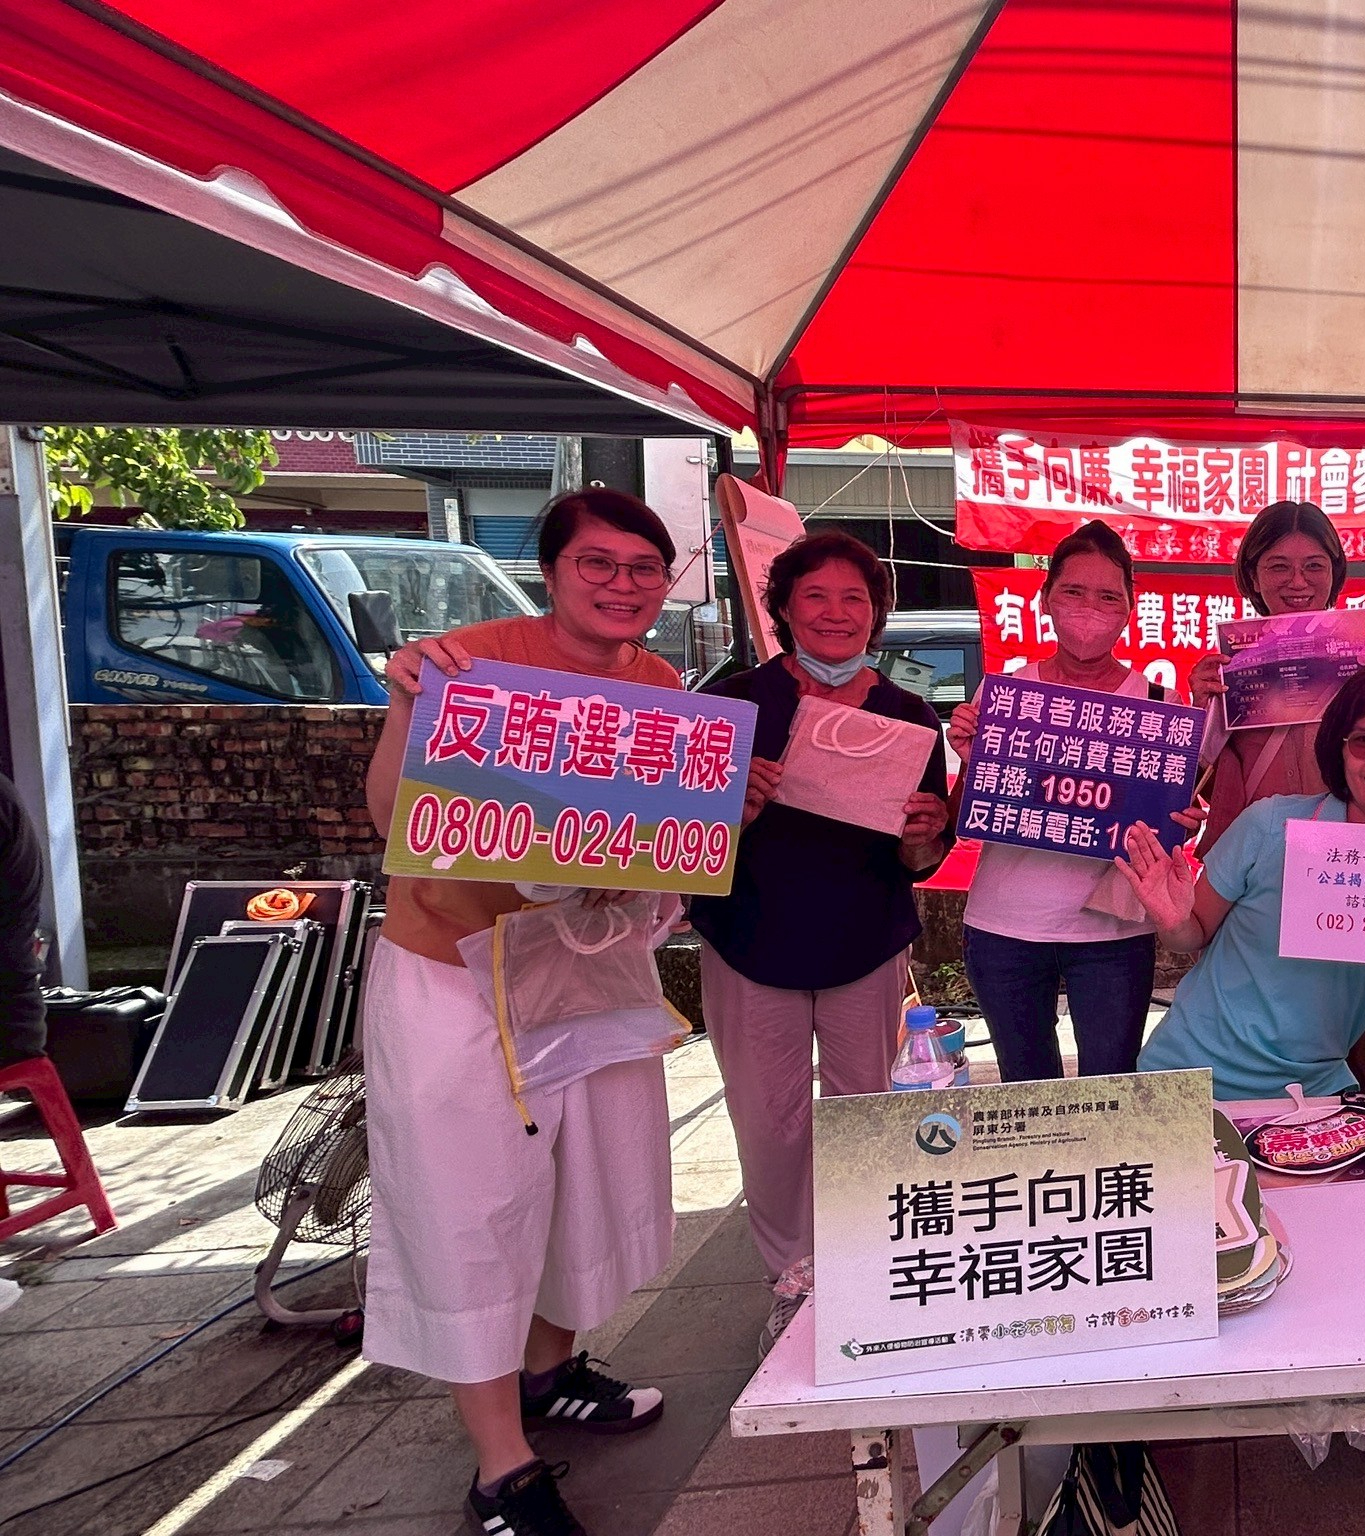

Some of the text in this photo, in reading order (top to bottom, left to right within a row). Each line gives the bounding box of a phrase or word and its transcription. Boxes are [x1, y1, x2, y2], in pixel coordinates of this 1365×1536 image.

[424, 681, 738, 793] 反賄選專線
[987, 684, 1195, 748] 消費者服務專線
[981, 723, 1187, 786] 有任何消費者疑義
[1041, 774, 1112, 810] 1950
[407, 793, 730, 875] 0800-024-099
[972, 1100, 1119, 1123] 農業部林業及自然保育署
[972, 1121, 1026, 1136] 屏東分署
[888, 1161, 1154, 1241] 攜手向廉
[889, 1226, 1153, 1306] 幸福家園
